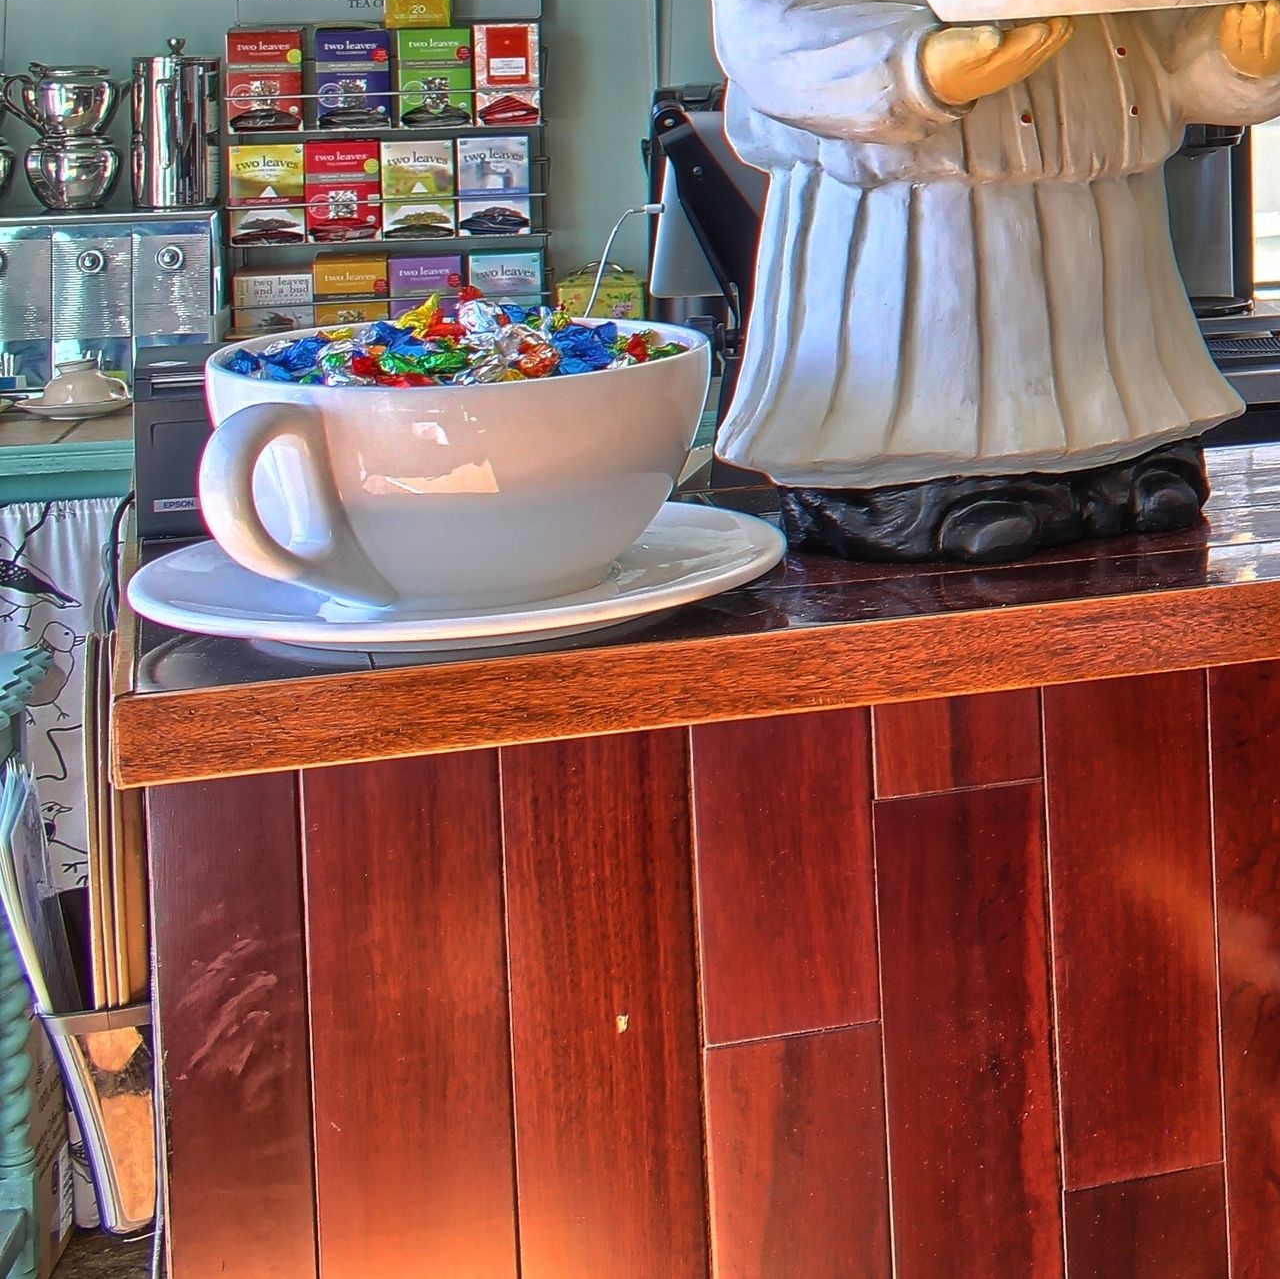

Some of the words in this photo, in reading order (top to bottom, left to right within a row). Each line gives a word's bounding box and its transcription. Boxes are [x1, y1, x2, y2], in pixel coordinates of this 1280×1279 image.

[411, 4, 426, 14] 20
[237, 43, 258, 51] two
[259, 41, 290, 50] leaves
[324, 42, 344, 50] two
[346, 40, 376, 49] leaves
[430, 38, 459, 47] leaves
[314, 154, 335, 162] two
[336, 151, 367, 160] leaves
[387, 156, 410, 166] two
[413, 151, 449, 165] leaves
[463, 152, 486, 163] two
[489, 148, 524, 162] leaves
[235, 159, 260, 171] two
[262, 155, 299, 169] leaves
[324, 274, 344, 282] two
[346, 271, 376, 280] leaves
[400, 269, 419, 277] two
[420, 266, 450, 276] leaves
[476, 270, 498, 280] two
[501, 264, 536, 278] leaves
[278, 277, 310, 286] leaves
[253, 286, 273, 295] and
[290, 284, 309, 294] bud
[163, 500, 194, 508] EPSON
